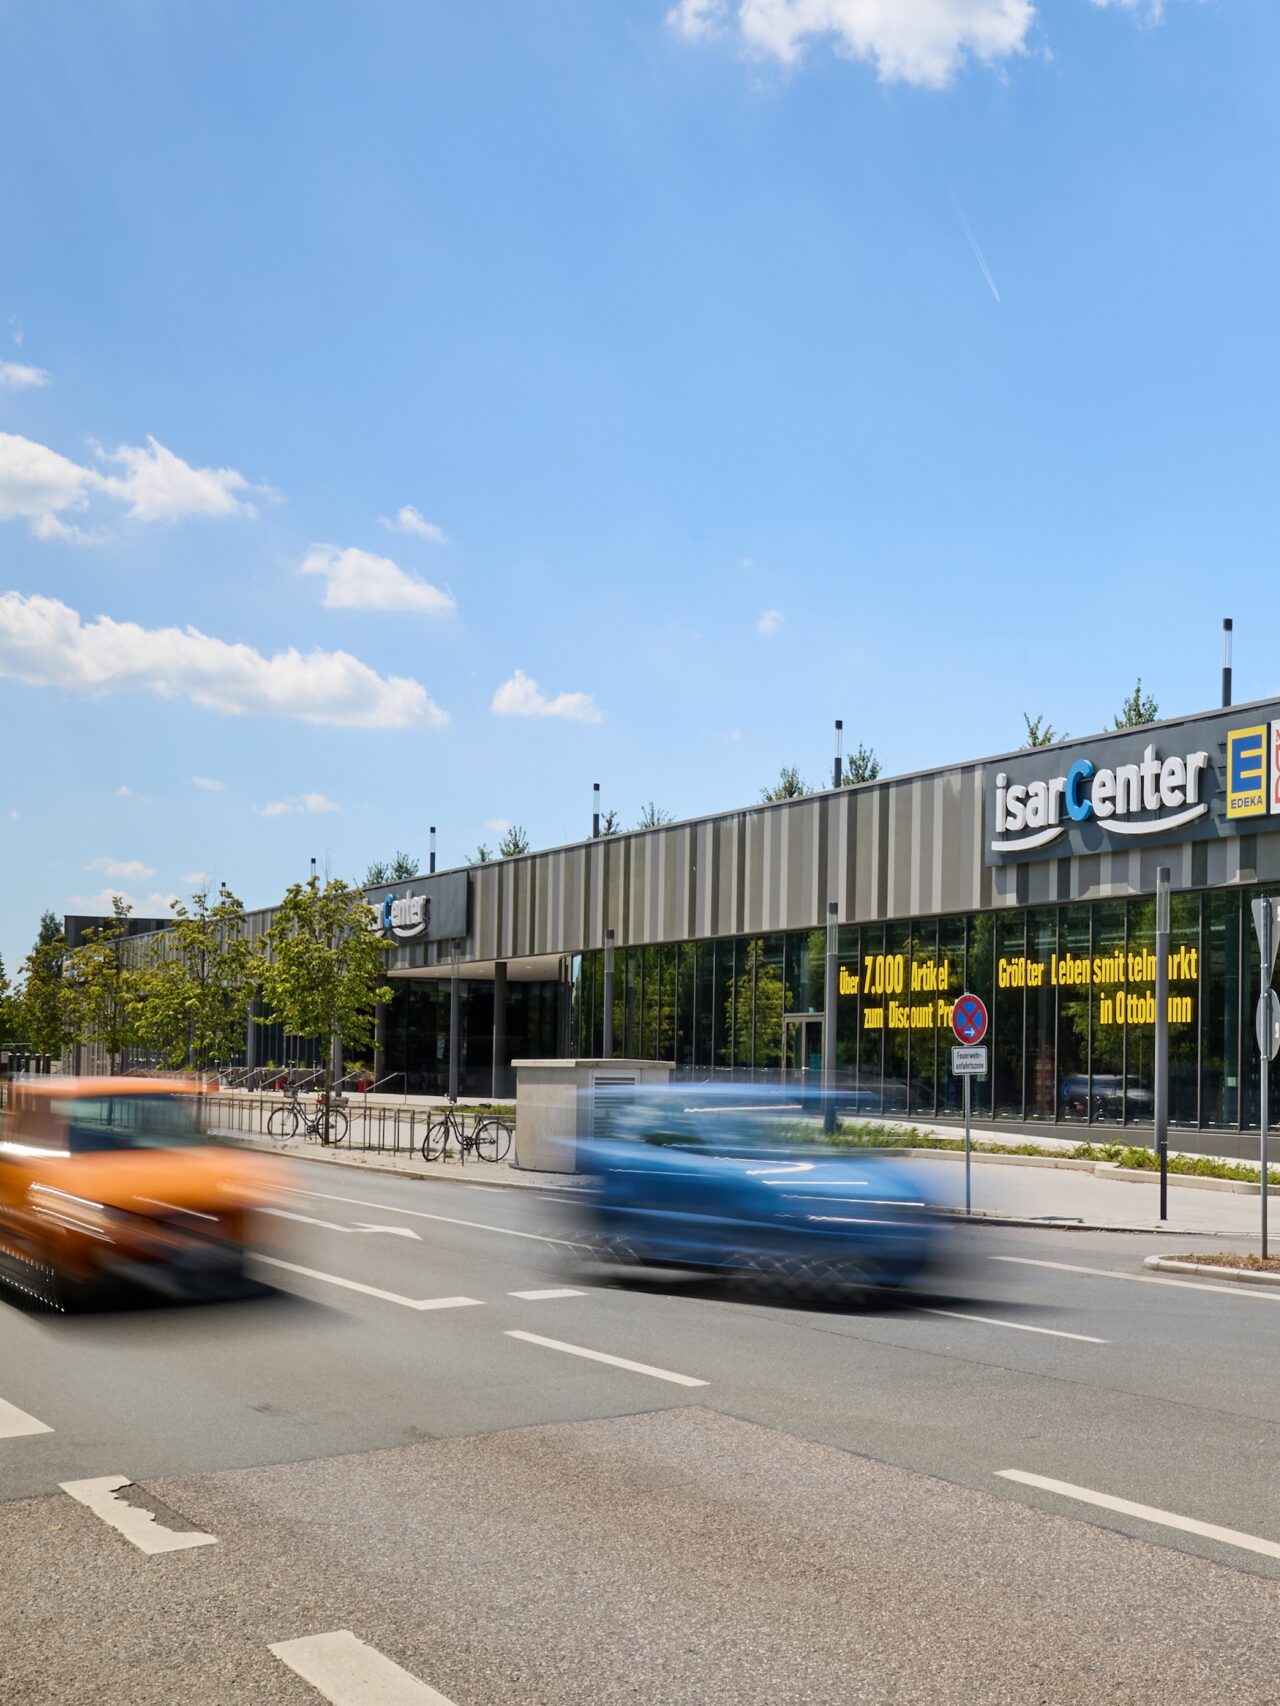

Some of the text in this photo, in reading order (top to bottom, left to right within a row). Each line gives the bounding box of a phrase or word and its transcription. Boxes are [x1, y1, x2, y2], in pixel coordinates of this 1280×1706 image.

[995, 743, 1209, 833] isarCenter
[1231, 795, 1263, 809] EDEKA
[839, 954, 948, 995] Über 7.000 Artikel
[999, 957, 1045, 988] Größter
[864, 1008, 884, 1029] zum
[888, 1001, 933, 1029] Discount
[1100, 990, 1192, 1024] in Ottobnn
